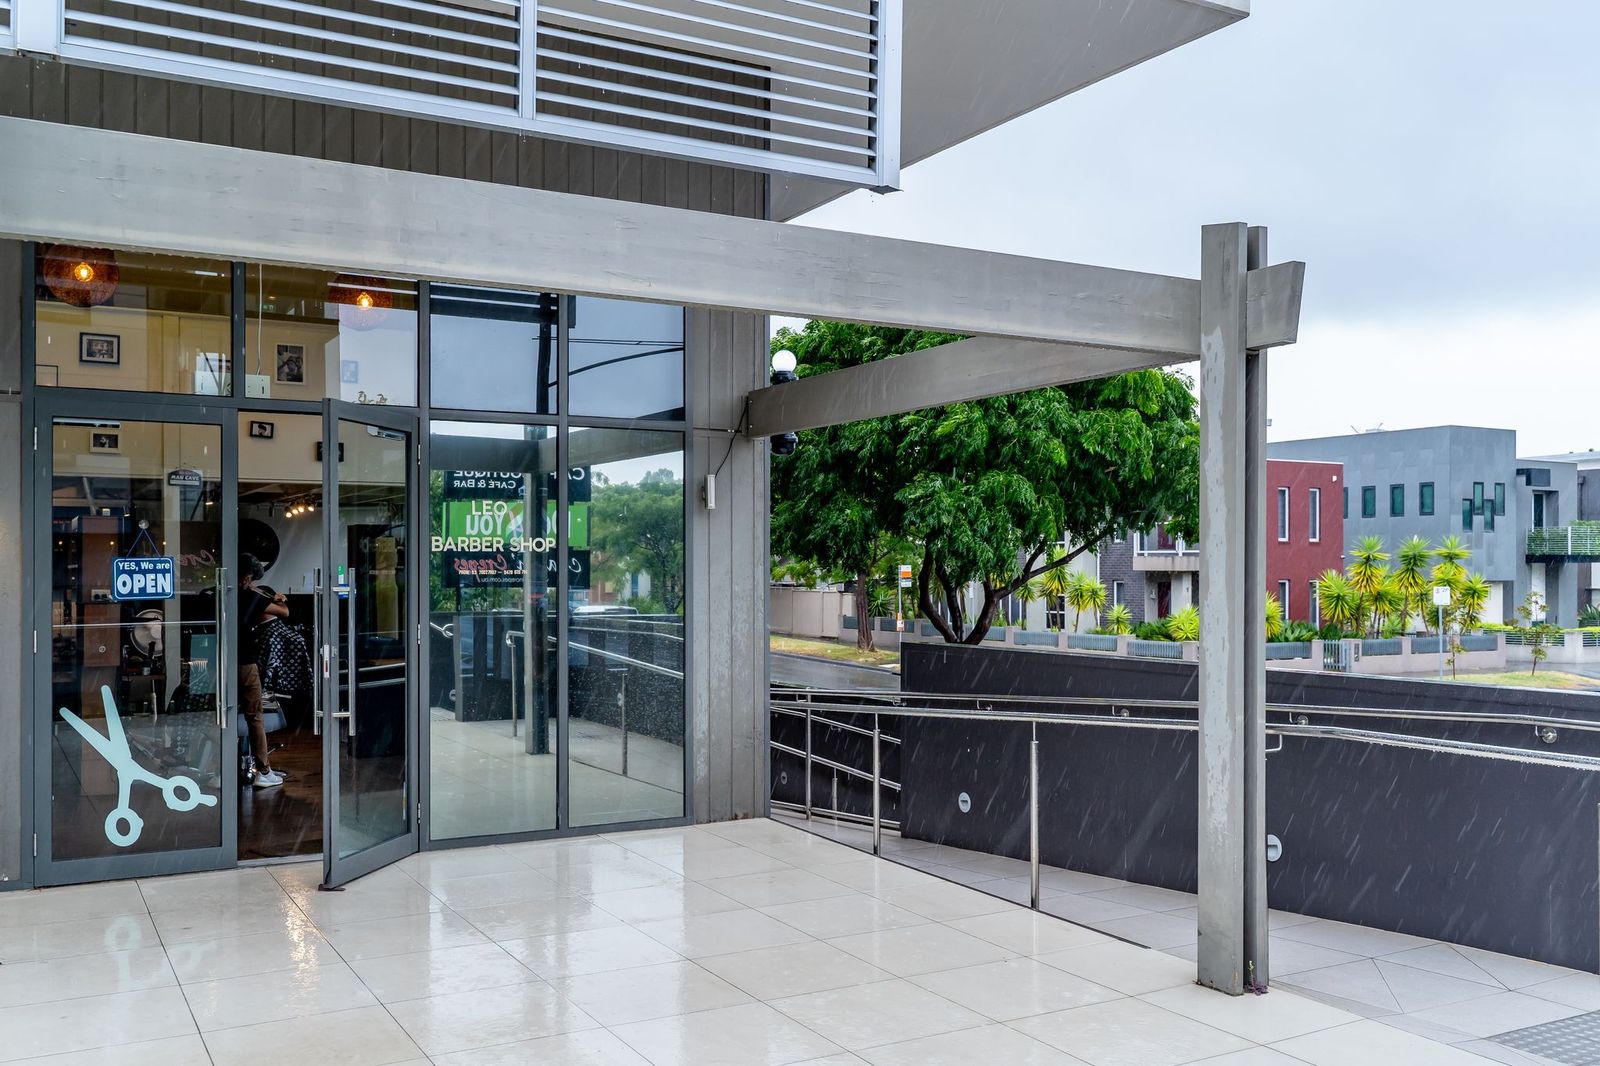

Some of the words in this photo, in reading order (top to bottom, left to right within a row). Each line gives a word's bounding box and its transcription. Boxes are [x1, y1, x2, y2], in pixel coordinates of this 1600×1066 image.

[472, 500, 507, 516] LEO
[431, 537, 504, 552] BARBER
[510, 537, 556, 552] SHOP
[118, 562, 139, 571] YES,
[140, 561, 154, 570] We
[156, 562, 170, 570] are
[116, 573, 171, 595] OPEN
